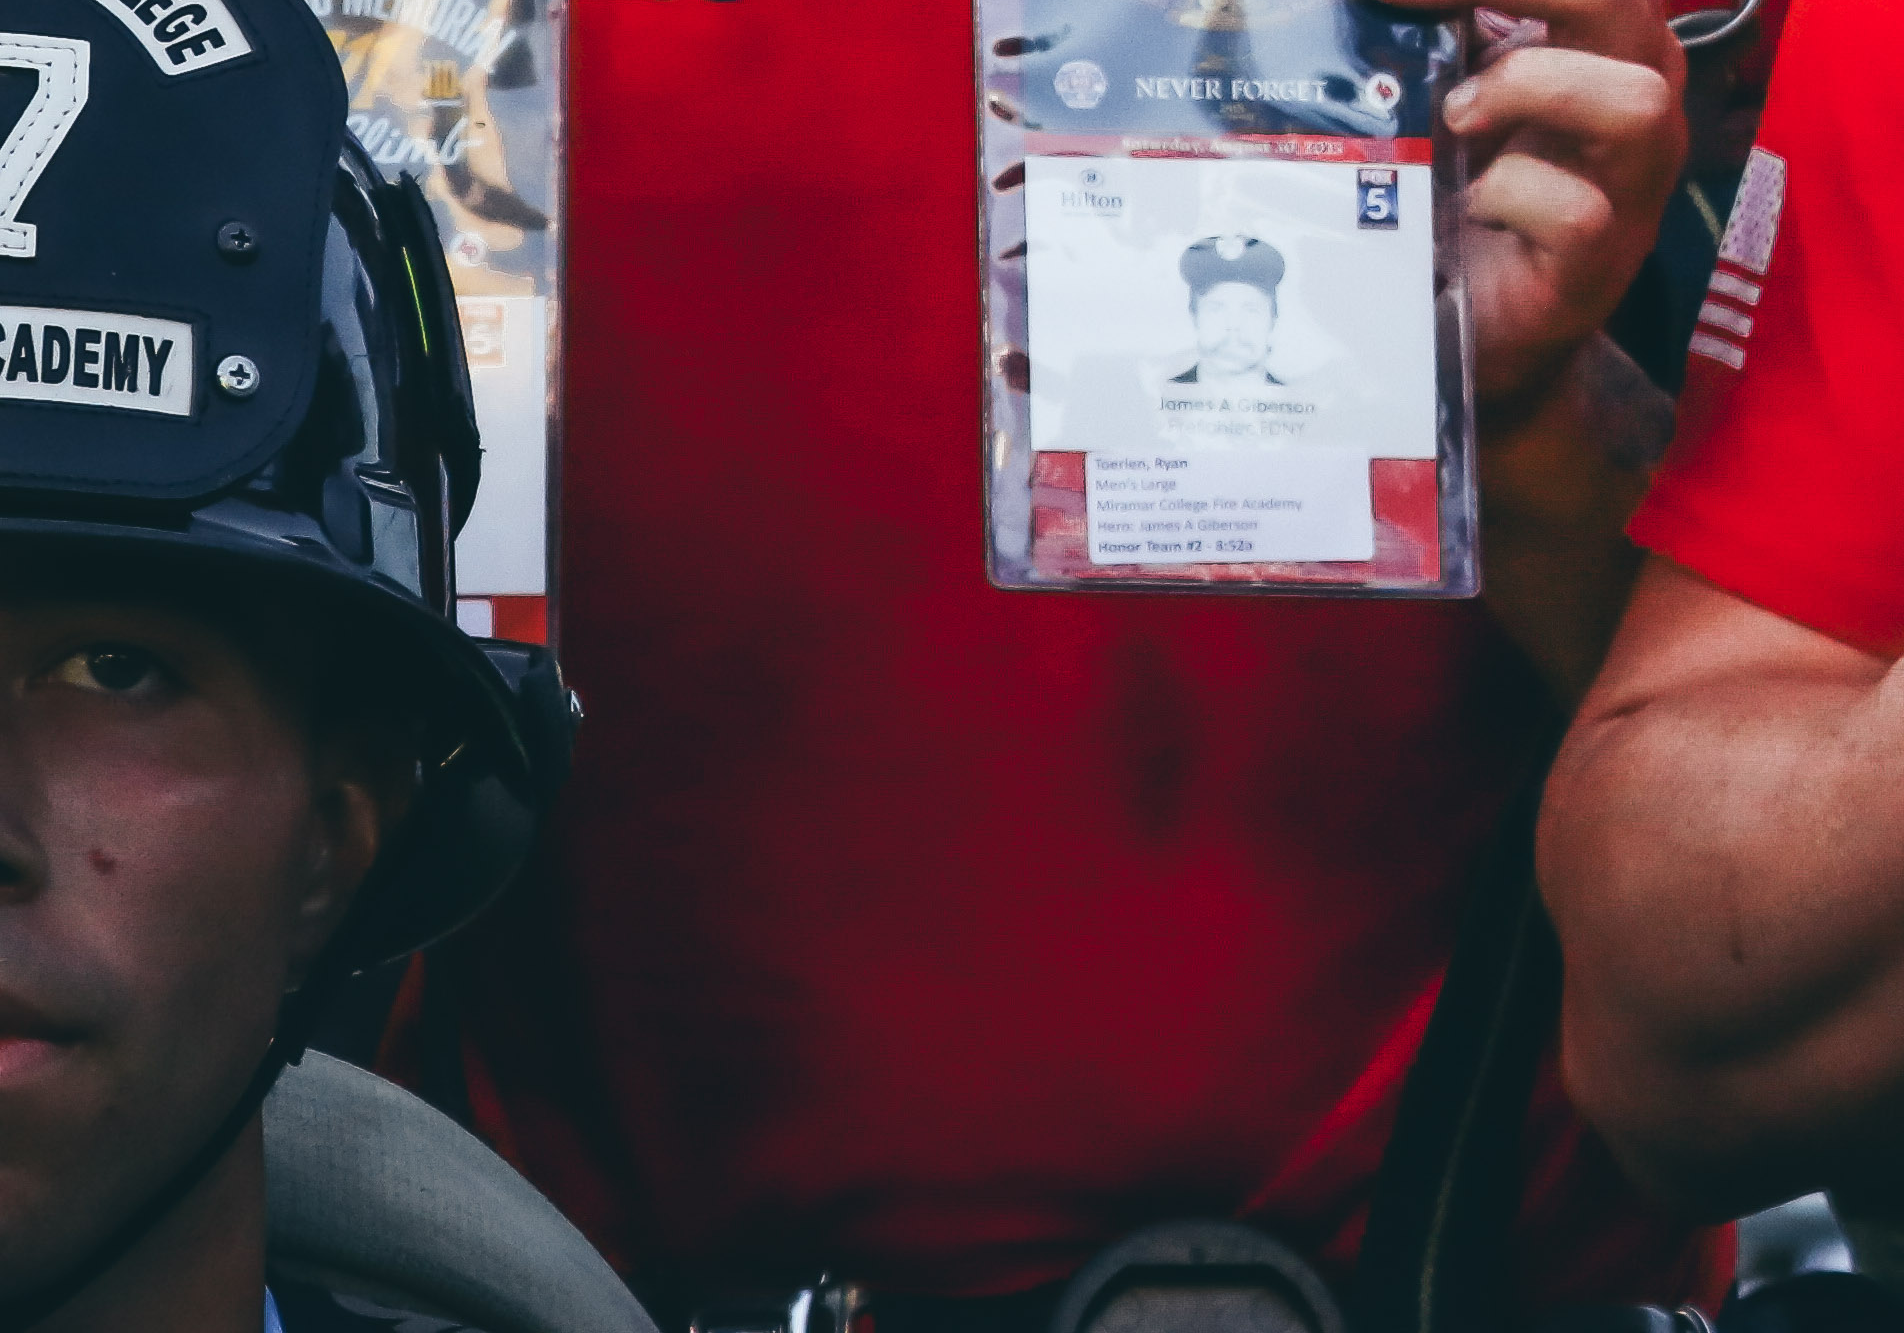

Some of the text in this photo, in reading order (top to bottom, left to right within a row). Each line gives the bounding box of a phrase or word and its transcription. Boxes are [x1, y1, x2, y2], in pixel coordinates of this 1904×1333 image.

[1135, 77, 1223, 101] NEVER
[1230, 79, 1328, 102] FORGET
[1060, 192, 1123, 210] Hilton
[1366, 188, 1391, 220] 5
[1160, 397, 1215, 413] James
[1219, 400, 1231, 413] A
[1154, 457, 1188, 471] Ryan
